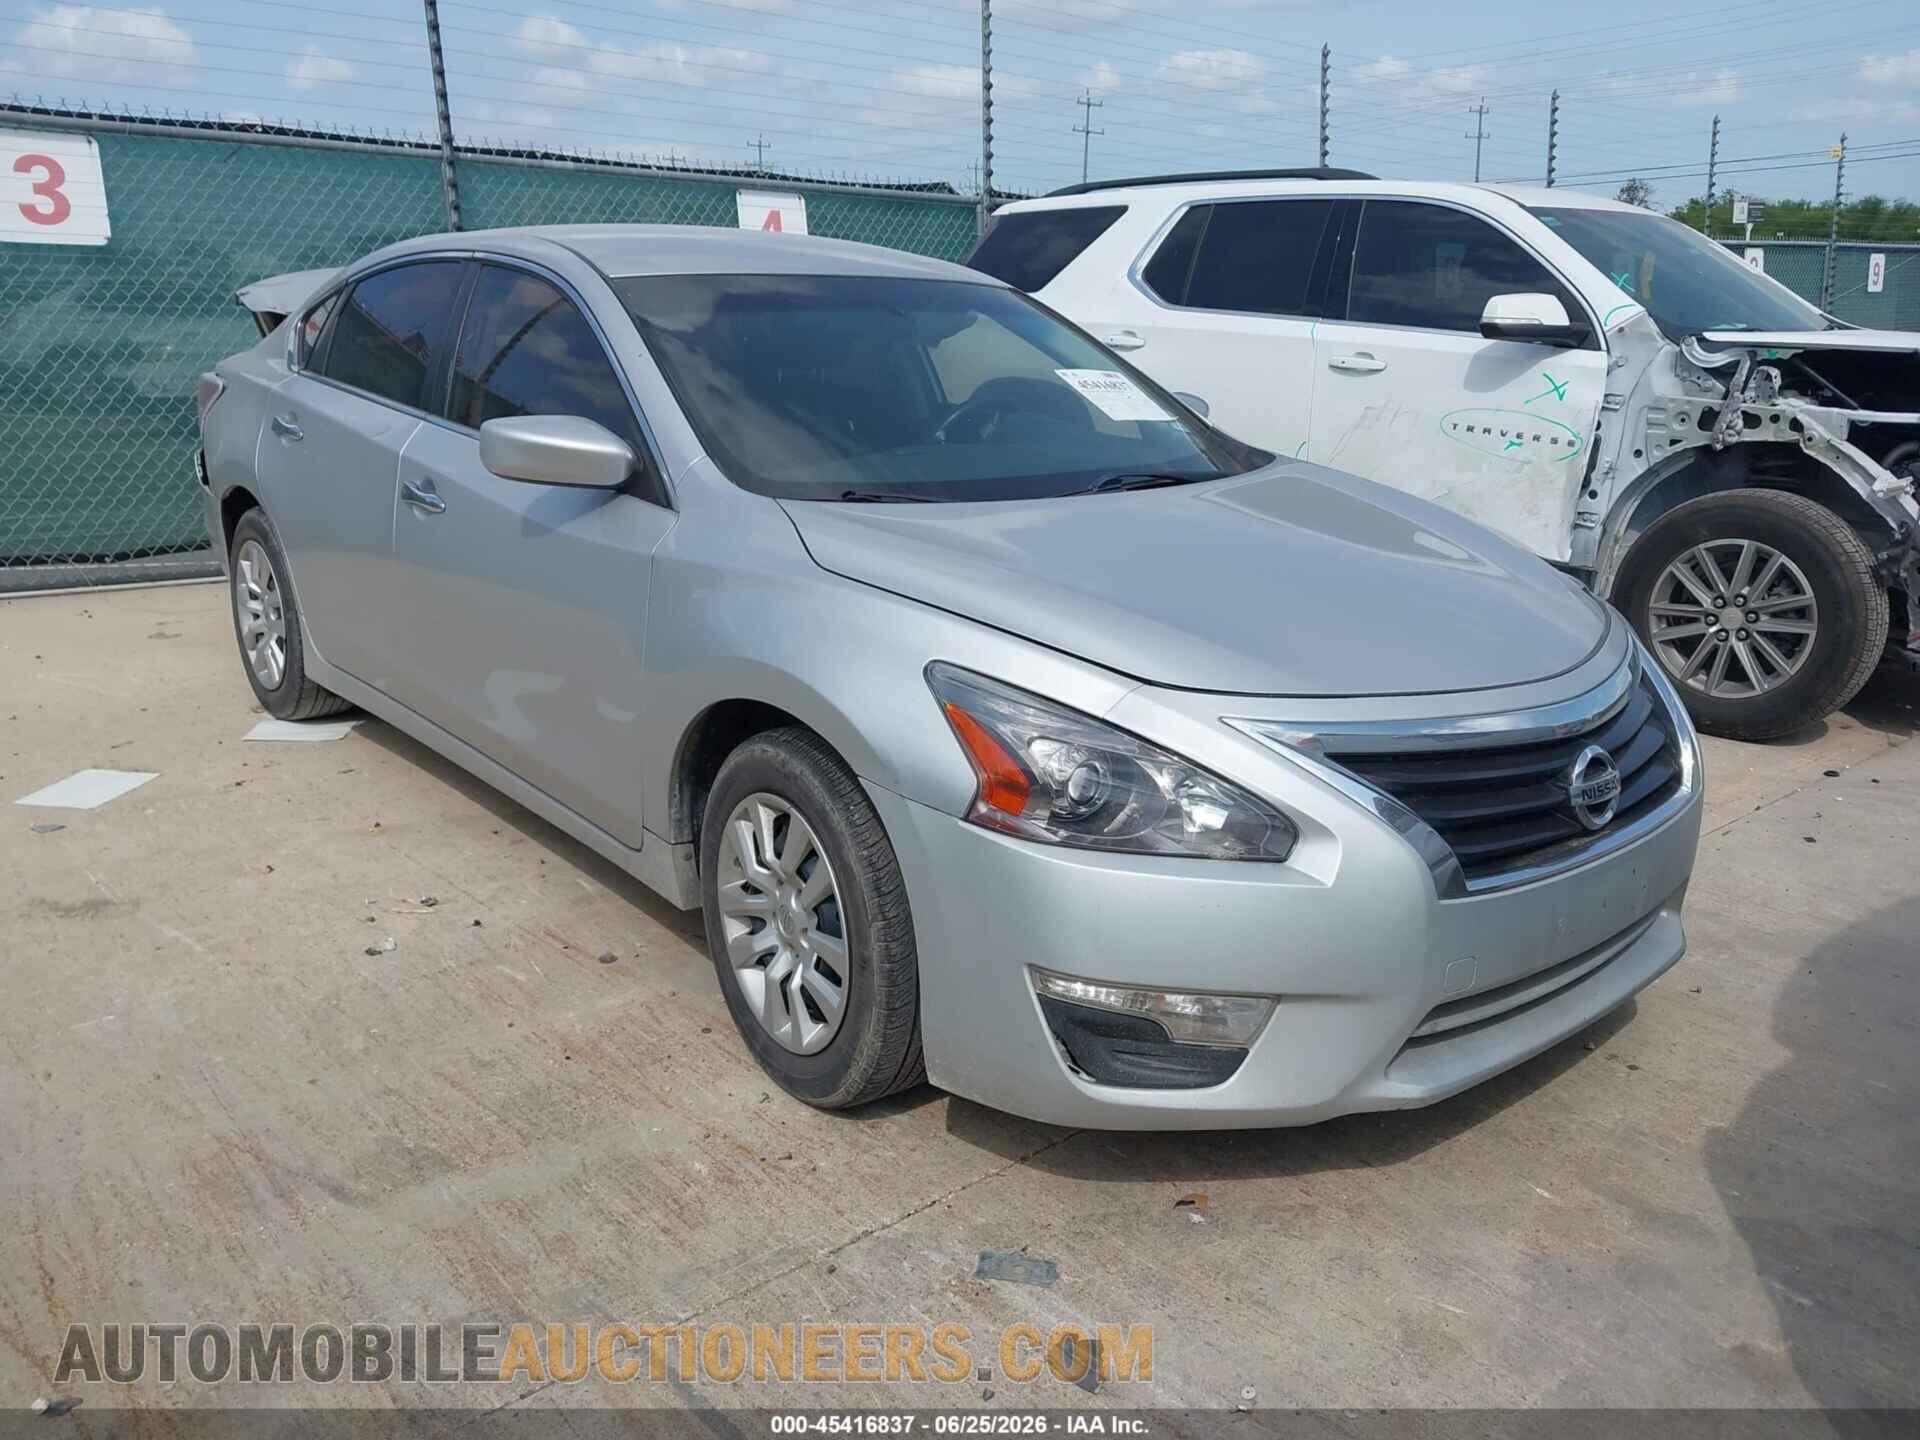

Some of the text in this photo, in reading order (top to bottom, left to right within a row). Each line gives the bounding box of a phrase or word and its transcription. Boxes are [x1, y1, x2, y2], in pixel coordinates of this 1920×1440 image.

[13, 154, 71, 226] 3
[1872, 262, 1881, 286] 9
[1451, 422, 1576, 448] TRAVERSE
